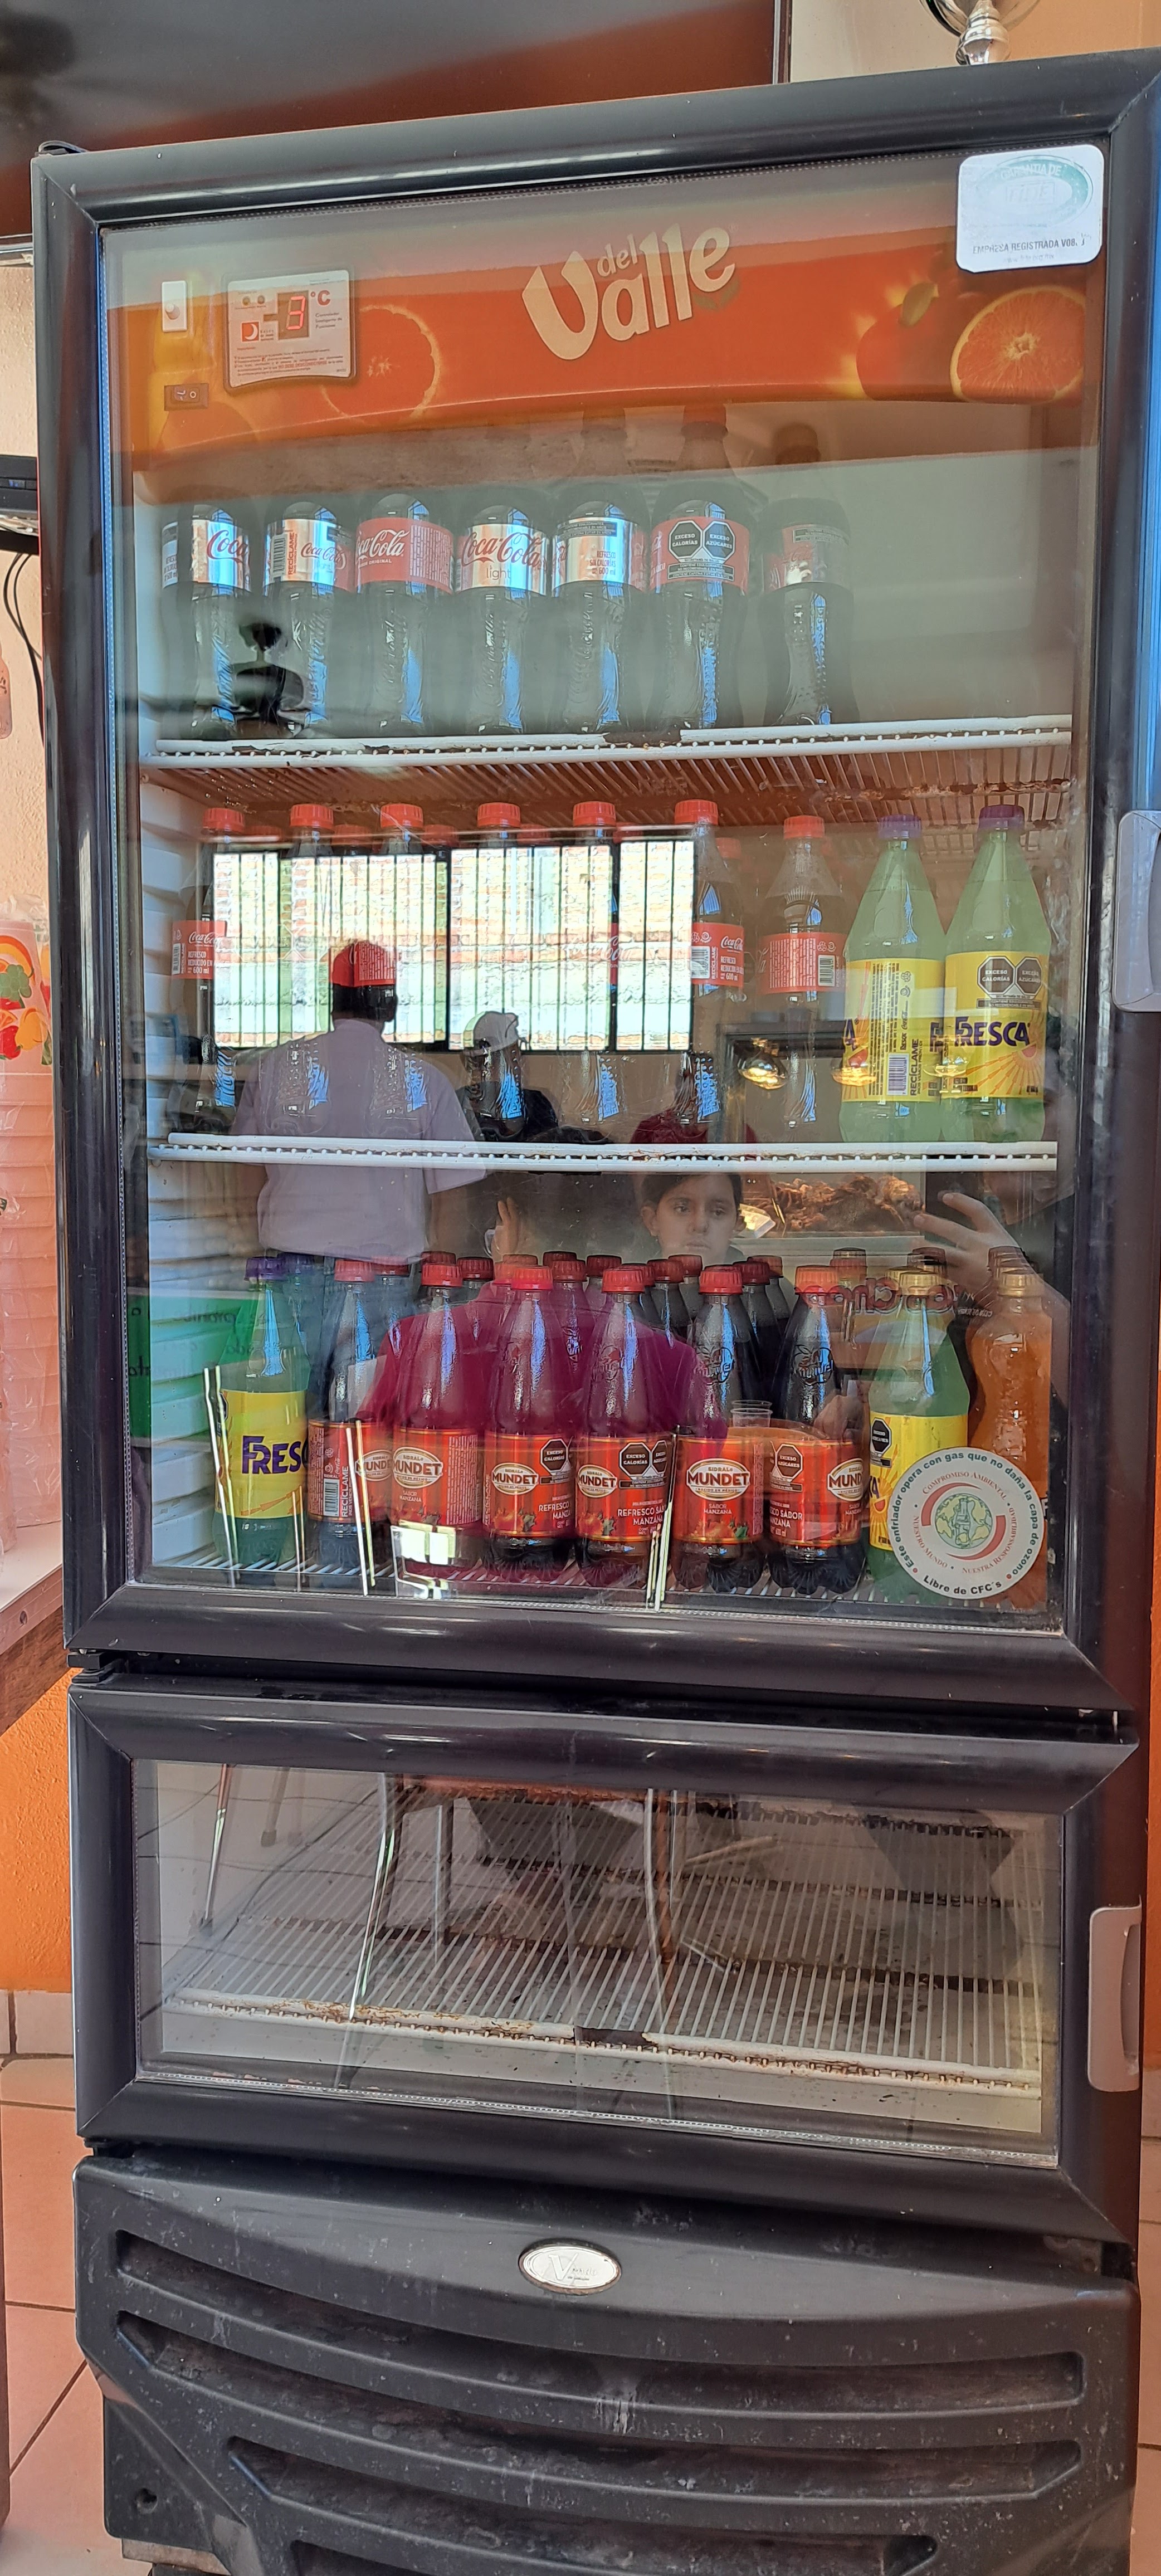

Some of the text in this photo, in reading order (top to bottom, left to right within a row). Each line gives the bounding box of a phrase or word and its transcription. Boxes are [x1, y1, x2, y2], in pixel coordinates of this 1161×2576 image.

[597, 233, 638, 277] del
[1011, 240, 1059, 251] REGISTRADA
[521, 223, 735, 360] Valle
[286, 296, 306, 330] 3
[461, 532, 547, 569] Coca-Cola
[706, 540, 733, 549] AZÚCARES
[486, 565, 511, 581] light
[954, 1016, 1030, 1047] FRESCA
[910, 1038, 919, 1096] RECÍCLAME
[923, 1457, 942, 1469] con
[945, 1452, 964, 1462] gas
[990, 1458, 1003, 1468] no
[394, 1460, 442, 1476] MUNDET
[492, 1471, 538, 1485] MUNDET
[687, 1471, 749, 1486] MUNDET
[1004, 1467, 1026, 1490] daña
[828, 1473, 862, 1488] MUND
[900, 1468, 923, 1494] opera
[922, 1471, 1007, 1501] COMPROMISO AMBIENTAL
[1023, 1490, 1032, 1501] la
[538, 1501, 570, 1513] REFRESCO
[552, 1510, 571, 1520] MANZA
[617, 1507, 655, 1517] REFRESCO
[780, 1509, 803, 1520] SABOR
[1029, 1503, 1039, 1529] capa
[890, 1494, 903, 1543] enfriador
[913, 1516, 948, 1568] NUESTRO MUNDO
[962, 1507, 1017, 1574] NUESTRA RESPONSABILIDAD
[898, 1545, 914, 1568] Este
[1012, 1548, 1033, 1575] ozono
[923, 1574, 950, 1592] Libre
[953, 1587, 967, 1595] de
